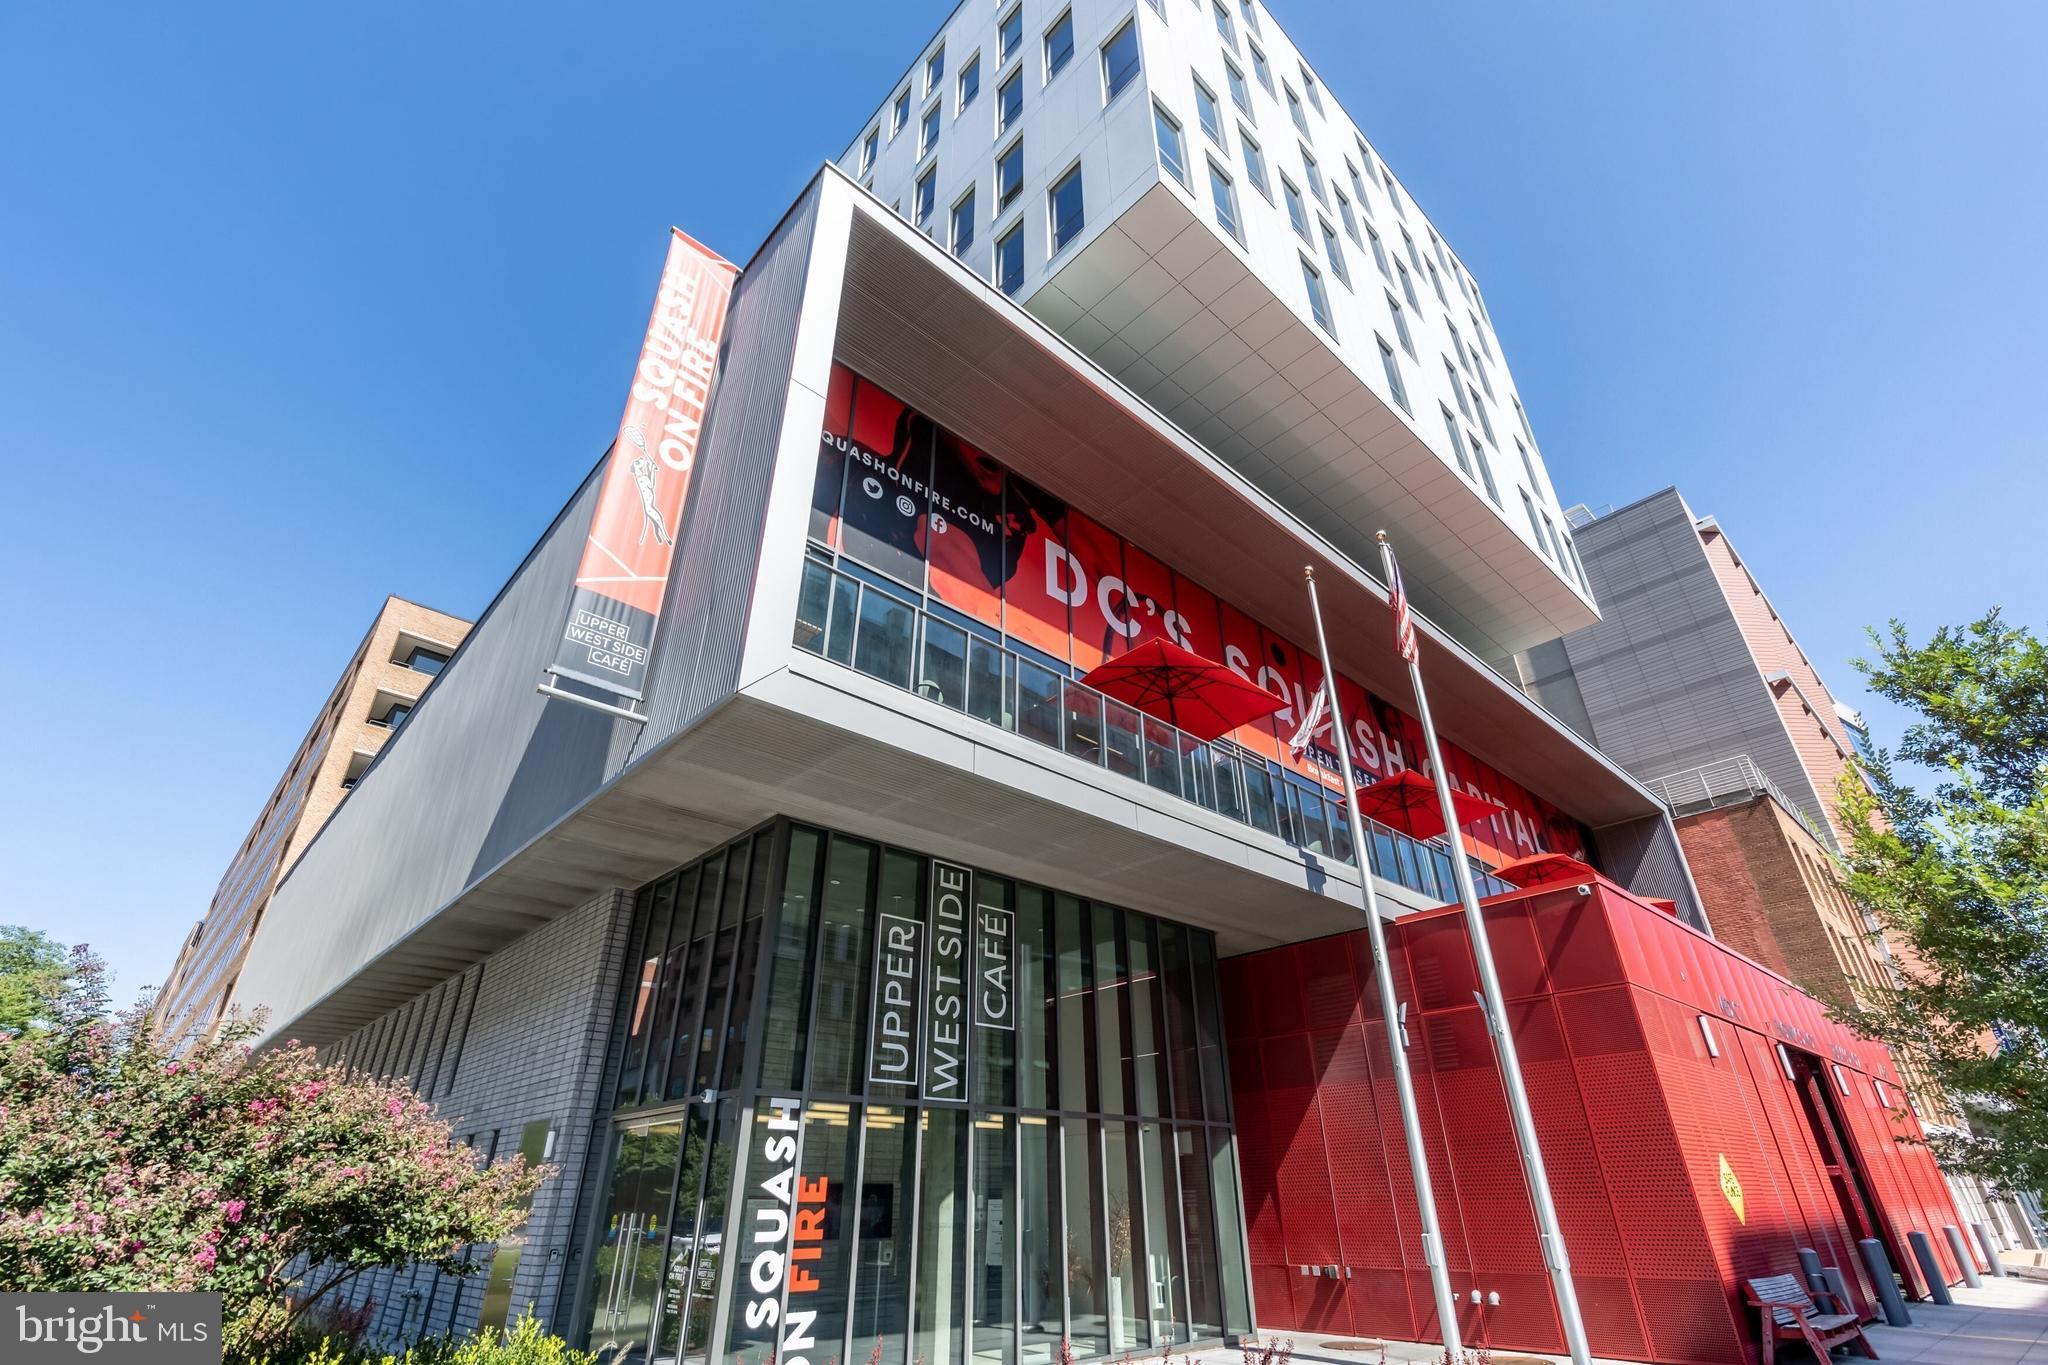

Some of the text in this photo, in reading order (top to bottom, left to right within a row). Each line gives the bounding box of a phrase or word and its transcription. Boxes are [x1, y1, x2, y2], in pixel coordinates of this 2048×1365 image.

[633, 263, 696, 411] SQUASH
[659, 326, 718, 472] ON FIRE
[822, 430, 995, 535] QUASHONFIRE.COM
[571, 626, 644, 661] WEST SIDE
[580, 613, 626, 639] UPPER
[1307, 745, 1334, 769] PEN
[880, 925, 915, 1072] UPPER
[932, 868, 964, 1093] WEST SIDE
[979, 912, 1008, 1019] CAFÉ
[745, 1097, 801, 1329] SQUASH
[788, 1175, 829, 1292] FIRE
